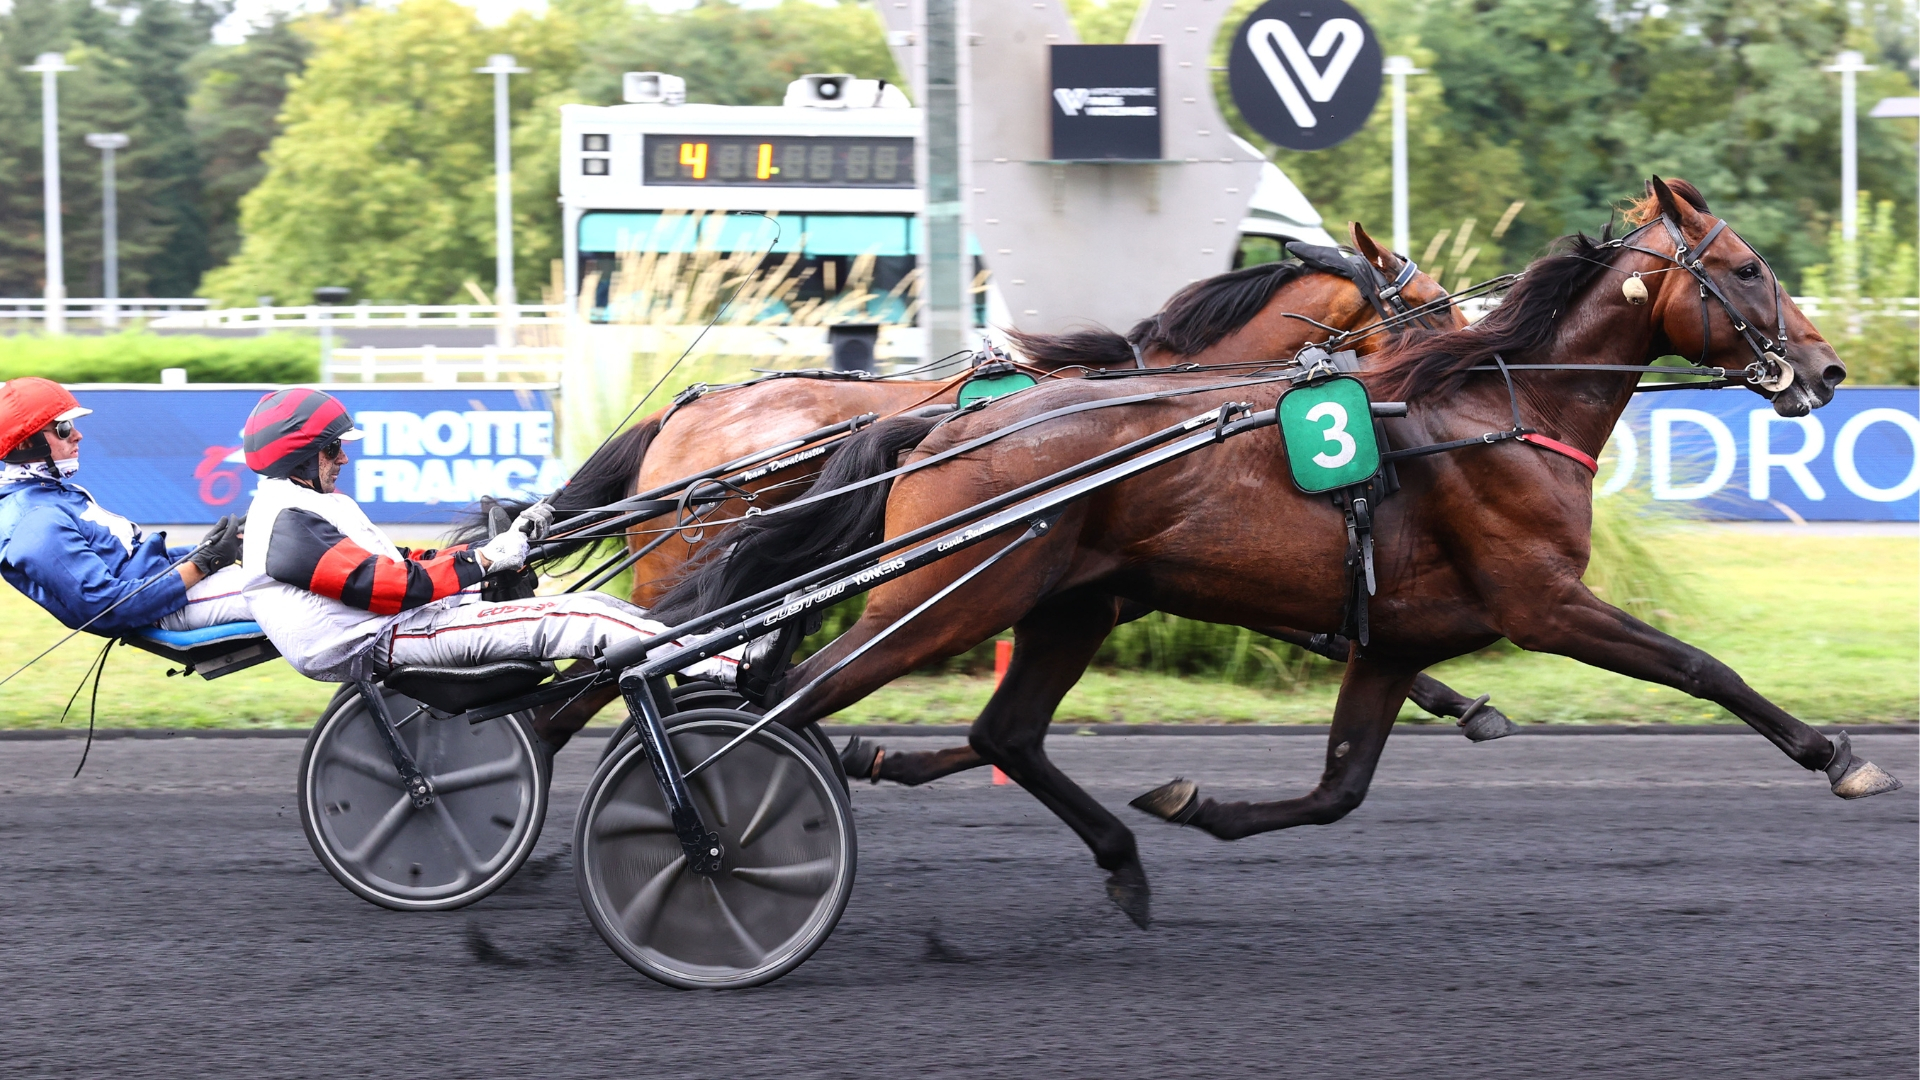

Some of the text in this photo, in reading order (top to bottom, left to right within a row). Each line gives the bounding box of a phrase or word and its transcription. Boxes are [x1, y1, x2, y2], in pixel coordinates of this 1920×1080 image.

[680, 143, 708, 179] 4
[355, 410, 554, 456] TROTTE
[1305, 401, 1357, 469] 3
[739, 446, 826, 481] Team Duvaldestin
[763, 557, 906, 626] CUSTOM YONKERS
